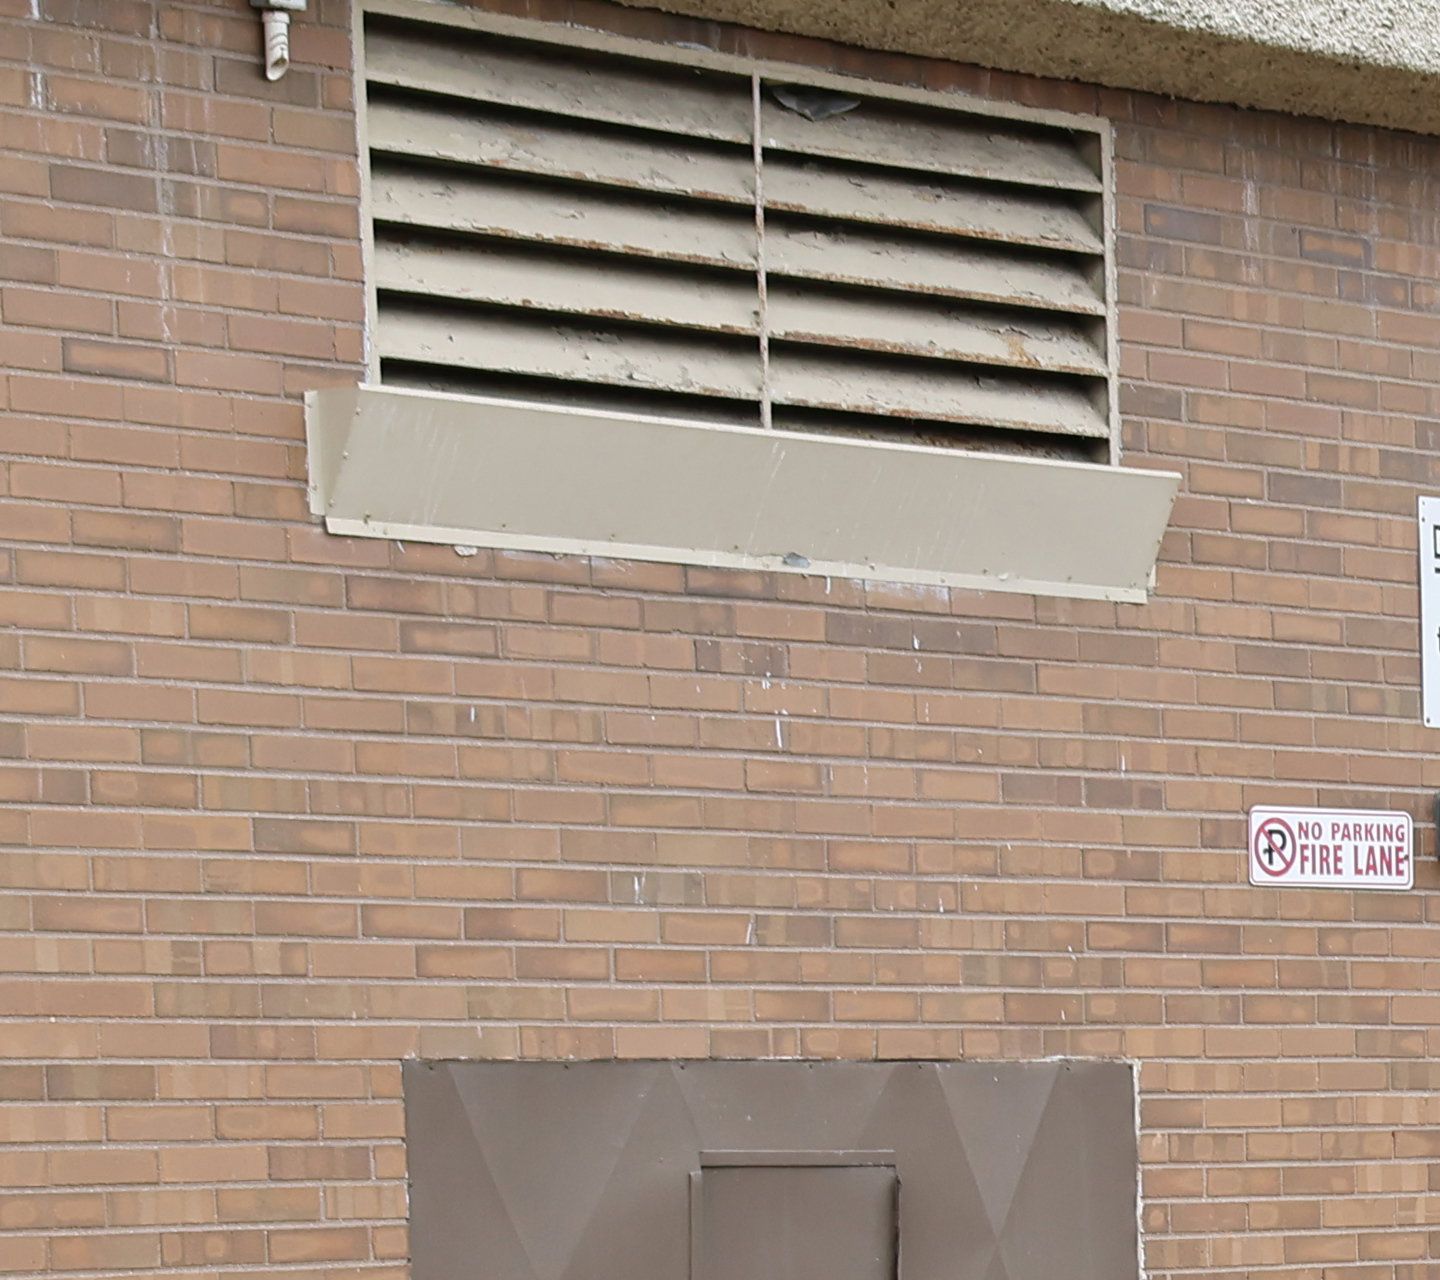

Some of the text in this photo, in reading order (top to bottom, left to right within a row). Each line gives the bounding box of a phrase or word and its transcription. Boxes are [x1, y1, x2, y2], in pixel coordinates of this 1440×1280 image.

[1297, 821, 1406, 843] NO PARKING
[1299, 844, 1406, 877] FIRE LANE
